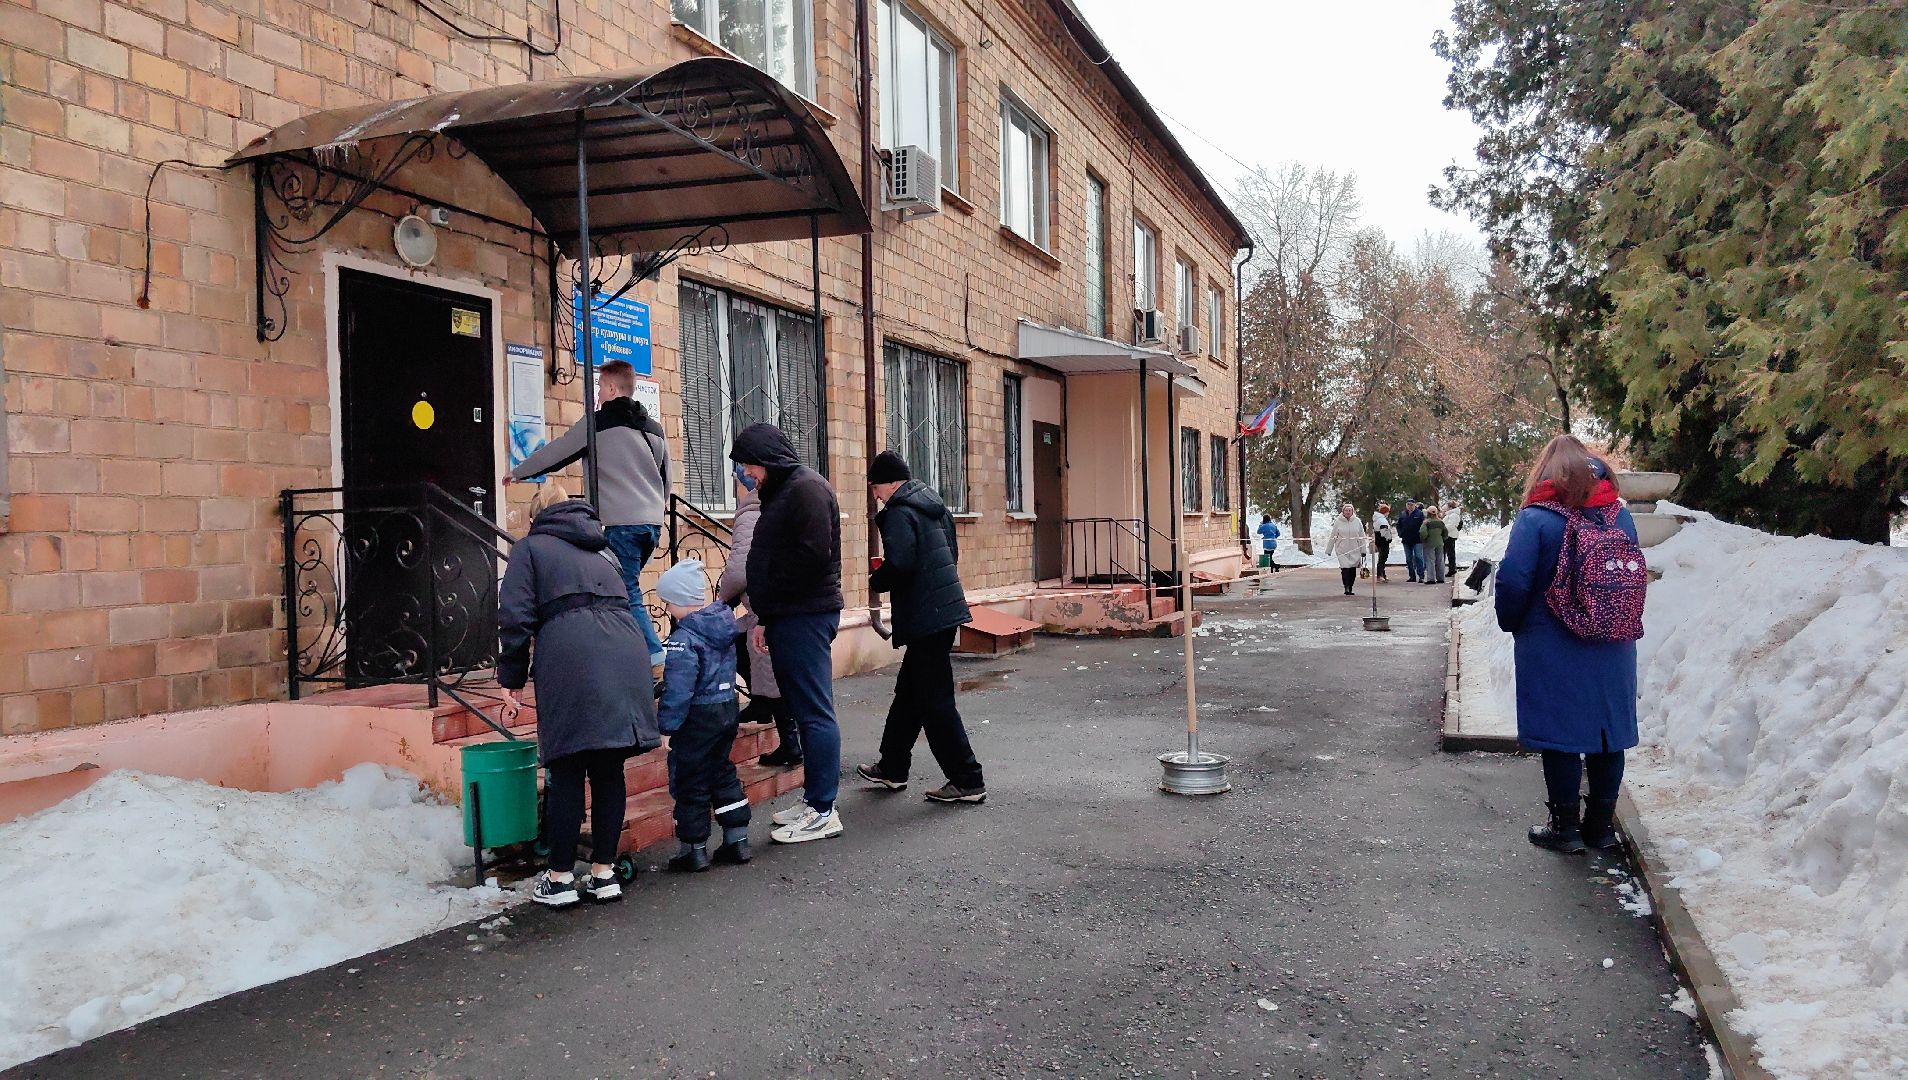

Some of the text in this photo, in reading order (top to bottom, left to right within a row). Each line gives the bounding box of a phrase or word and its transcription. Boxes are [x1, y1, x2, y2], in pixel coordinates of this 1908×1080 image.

[600, 328, 627, 342] культуры
[507, 344, 543, 358] ИНФОРМАЦИЯ
[635, 384, 657, 395] ЧАСТОК
